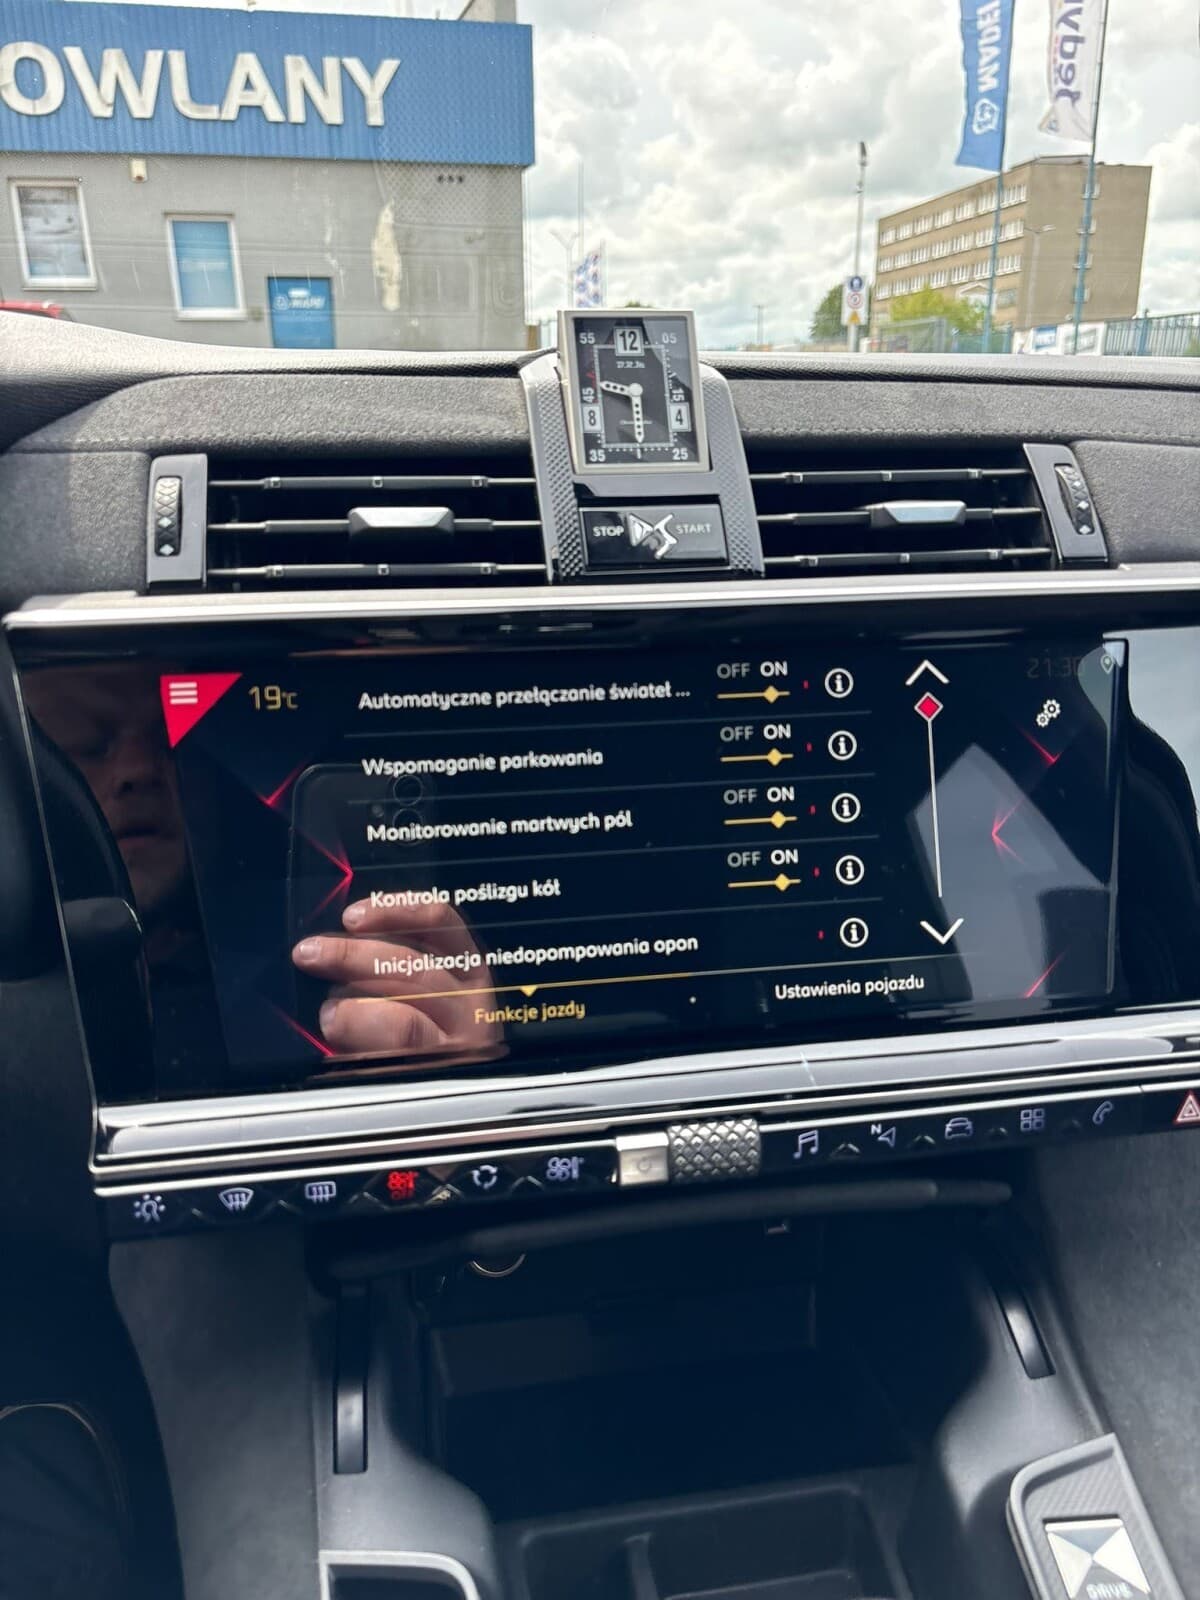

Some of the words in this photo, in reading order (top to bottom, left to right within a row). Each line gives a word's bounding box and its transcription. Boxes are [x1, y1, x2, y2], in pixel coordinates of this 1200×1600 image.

[579, 332, 596, 345] 55
[619, 330, 639, 352] 12
[661, 332, 678, 344] 05
[587, 409, 597, 427] 8
[675, 408, 684, 426] 4
[589, 449, 606, 462] 35
[672, 447, 689, 460] 25
[592, 525, 624, 537] STOP
[676, 523, 711, 535] START
[716, 663, 750, 679] OFF
[760, 661, 788, 677] ON
[358, 689, 492, 711] Automatyczne
[496, 684, 606, 708] przełączanie
[720, 725, 754, 742] OFF
[763, 724, 792, 740] ON
[361, 754, 497, 777] Wspomaganie
[499, 748, 604, 773] parkowania
[723, 788, 758, 805] OFF
[767, 786, 795, 803] ON
[366, 818, 508, 842] Monitorowanie
[510, 811, 601, 835] martwych
[603, 809, 633, 831] pól
[727, 851, 762, 868] OFF
[770, 848, 799, 865] ON
[370, 886, 450, 908] Kontrola
[454, 883, 529, 906] poślizgu
[532, 878, 561, 897] kół
[373, 952, 482, 978] Inicjalizacja
[485, 939, 650, 967] niedopompowania
[653, 937, 699, 957] opon
[774, 981, 862, 1001] Ustawienia
[864, 974, 926, 998] pojazdu
[474, 1005, 539, 1025] Funkcje
[542, 1001, 586, 1022] jazdy
